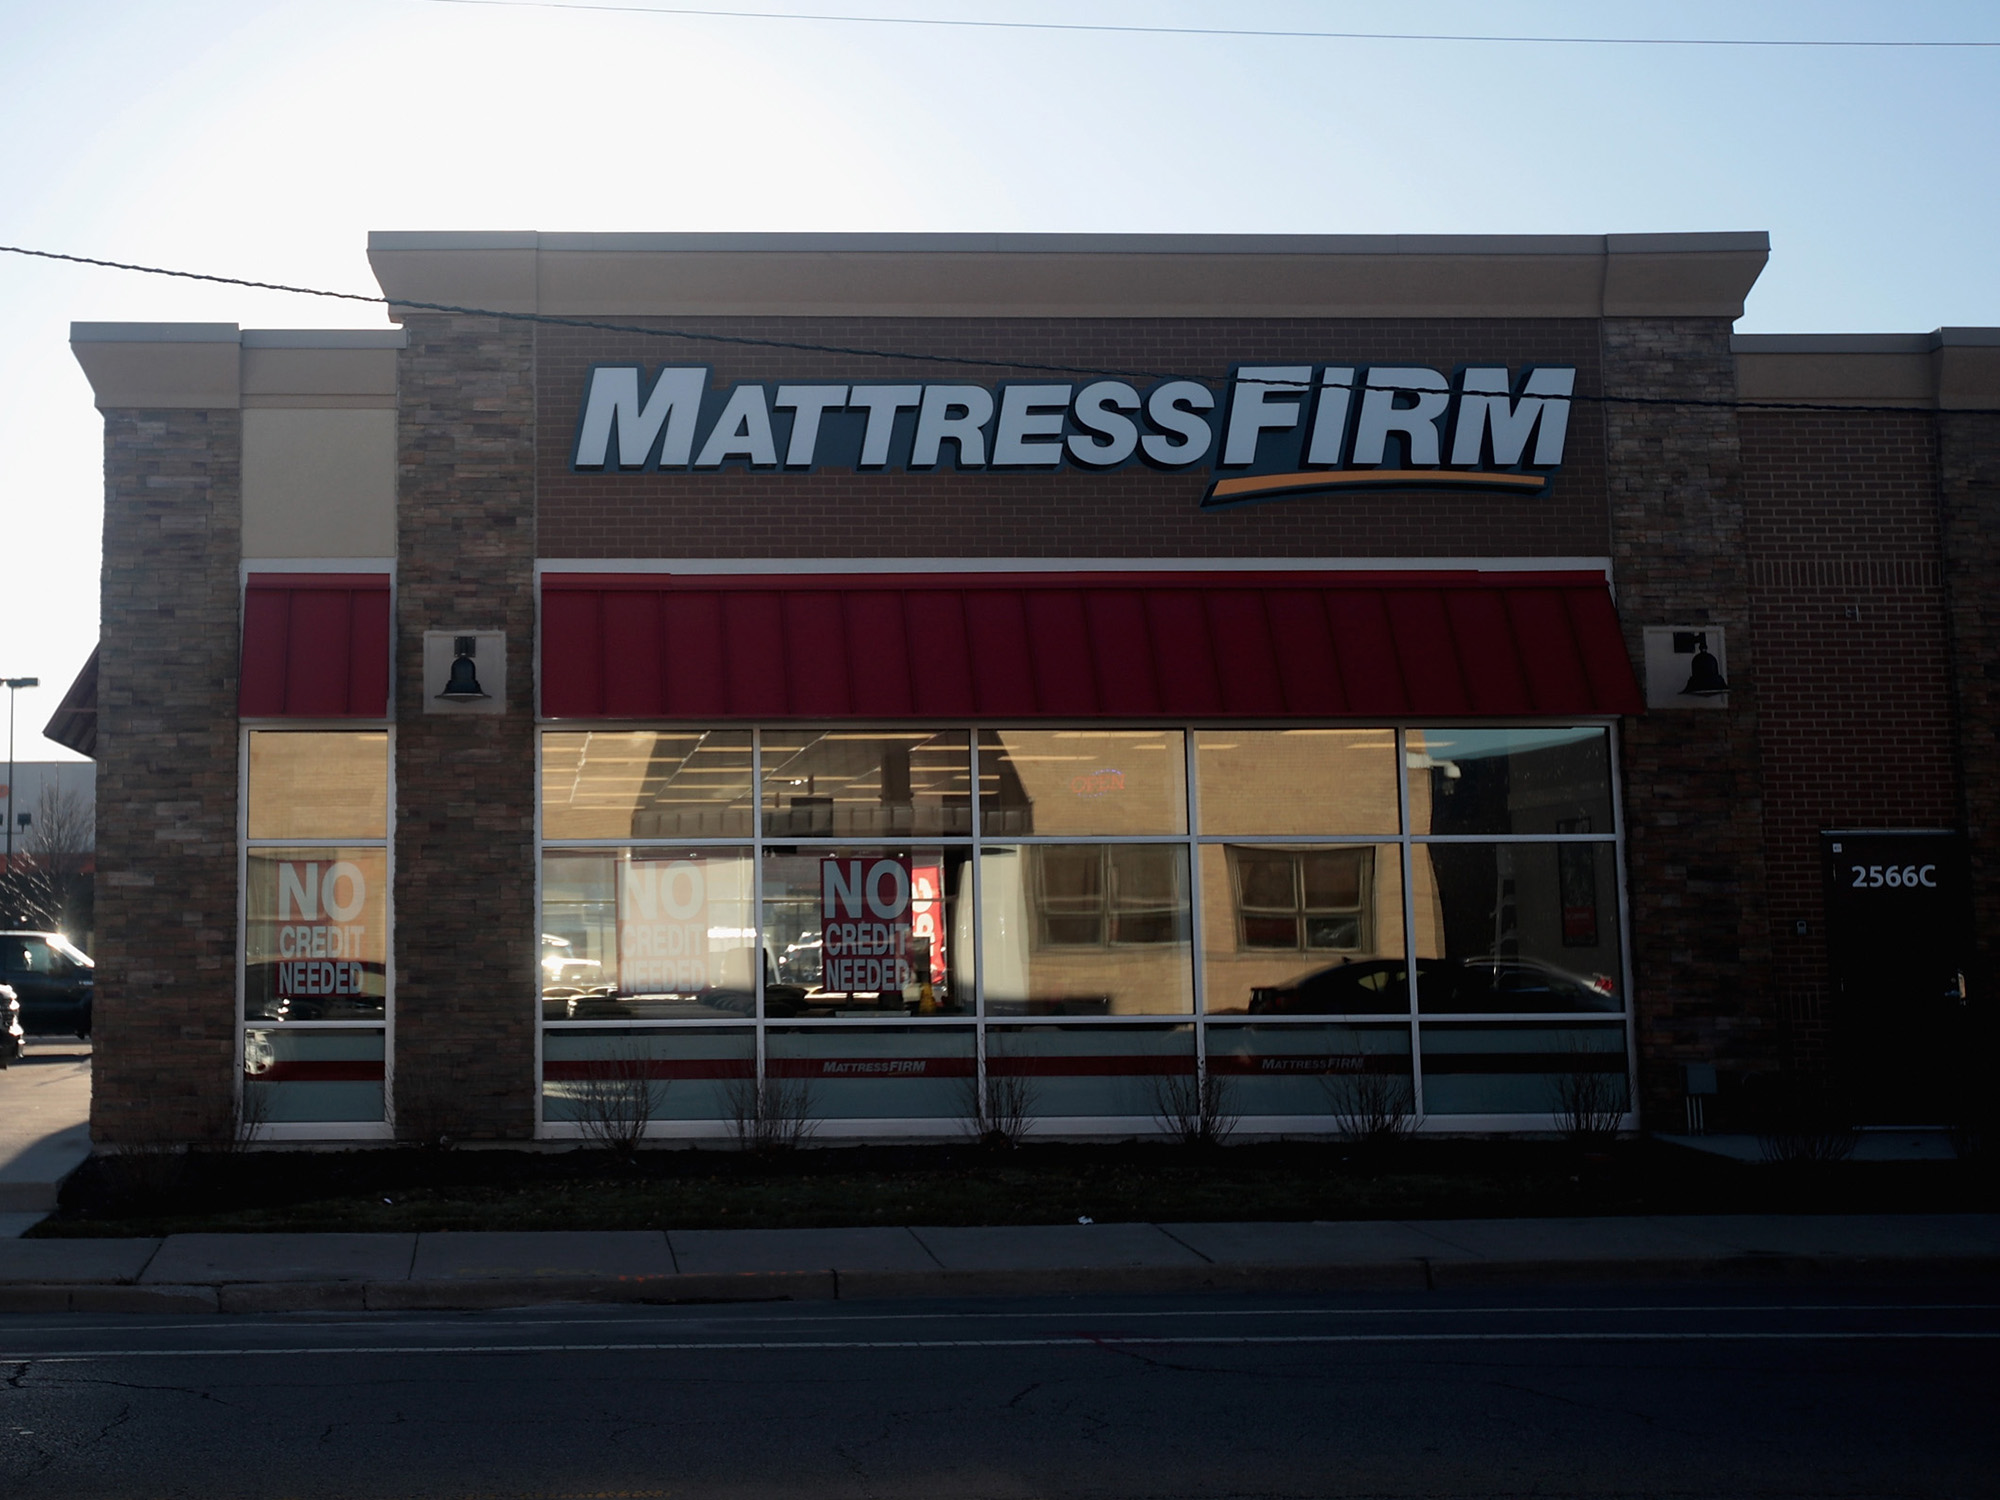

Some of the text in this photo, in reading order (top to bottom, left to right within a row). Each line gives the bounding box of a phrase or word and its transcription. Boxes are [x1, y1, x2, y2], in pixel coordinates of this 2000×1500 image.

[1071, 774, 1126, 793] OPEN
[279, 861, 365, 922] NO
[618, 860, 705, 920] NO
[823, 859, 910, 920] NO
[1851, 864, 1937, 888] 2566C
[280, 925, 365, 958] CREDIT
[621, 923, 705, 957] CREDIT
[825, 923, 911, 956] CREDIT
[280, 961, 364, 994] NEEDED
[621, 959, 705, 993] NEEDED
[826, 958, 911, 992] NEEDED
